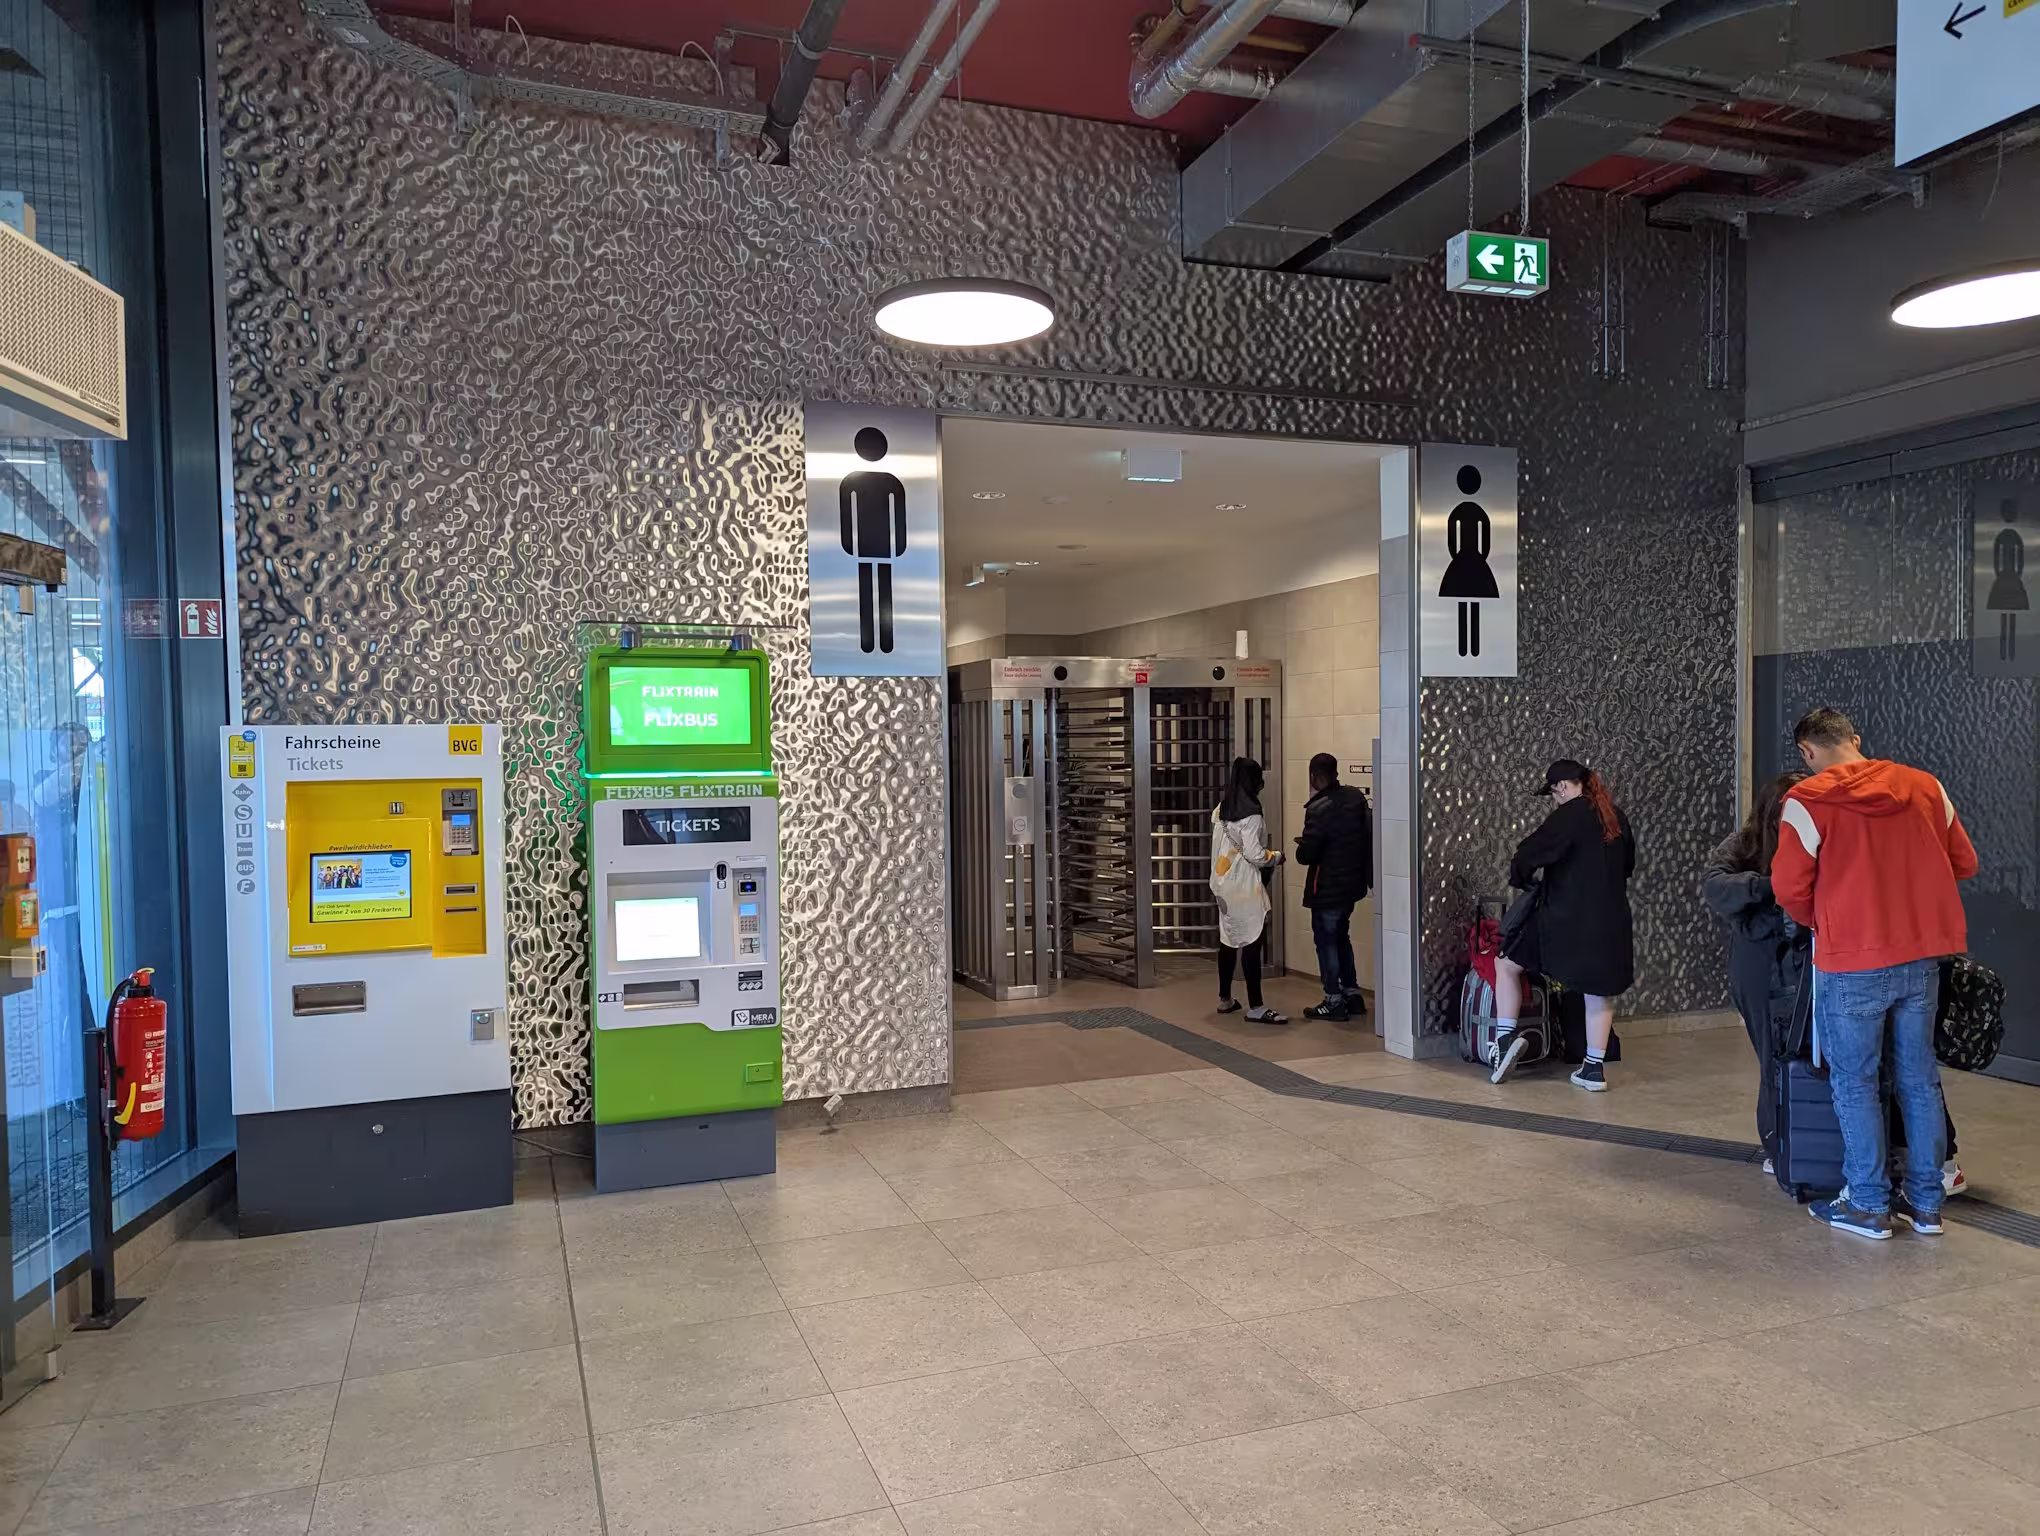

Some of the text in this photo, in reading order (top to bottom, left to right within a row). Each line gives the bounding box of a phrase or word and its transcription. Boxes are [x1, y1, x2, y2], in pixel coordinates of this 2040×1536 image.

[285, 735, 381, 749] Fahrscheine
[453, 739, 478, 752] BVG
[286, 756, 344, 771] Tickets
[237, 805, 250, 819] S
[238, 825, 250, 837] U
[656, 818, 721, 833] TICKETS
[238, 864, 254, 872] BUS
[240, 880, 250, 893] F
[751, 1013, 774, 1021] MERA
